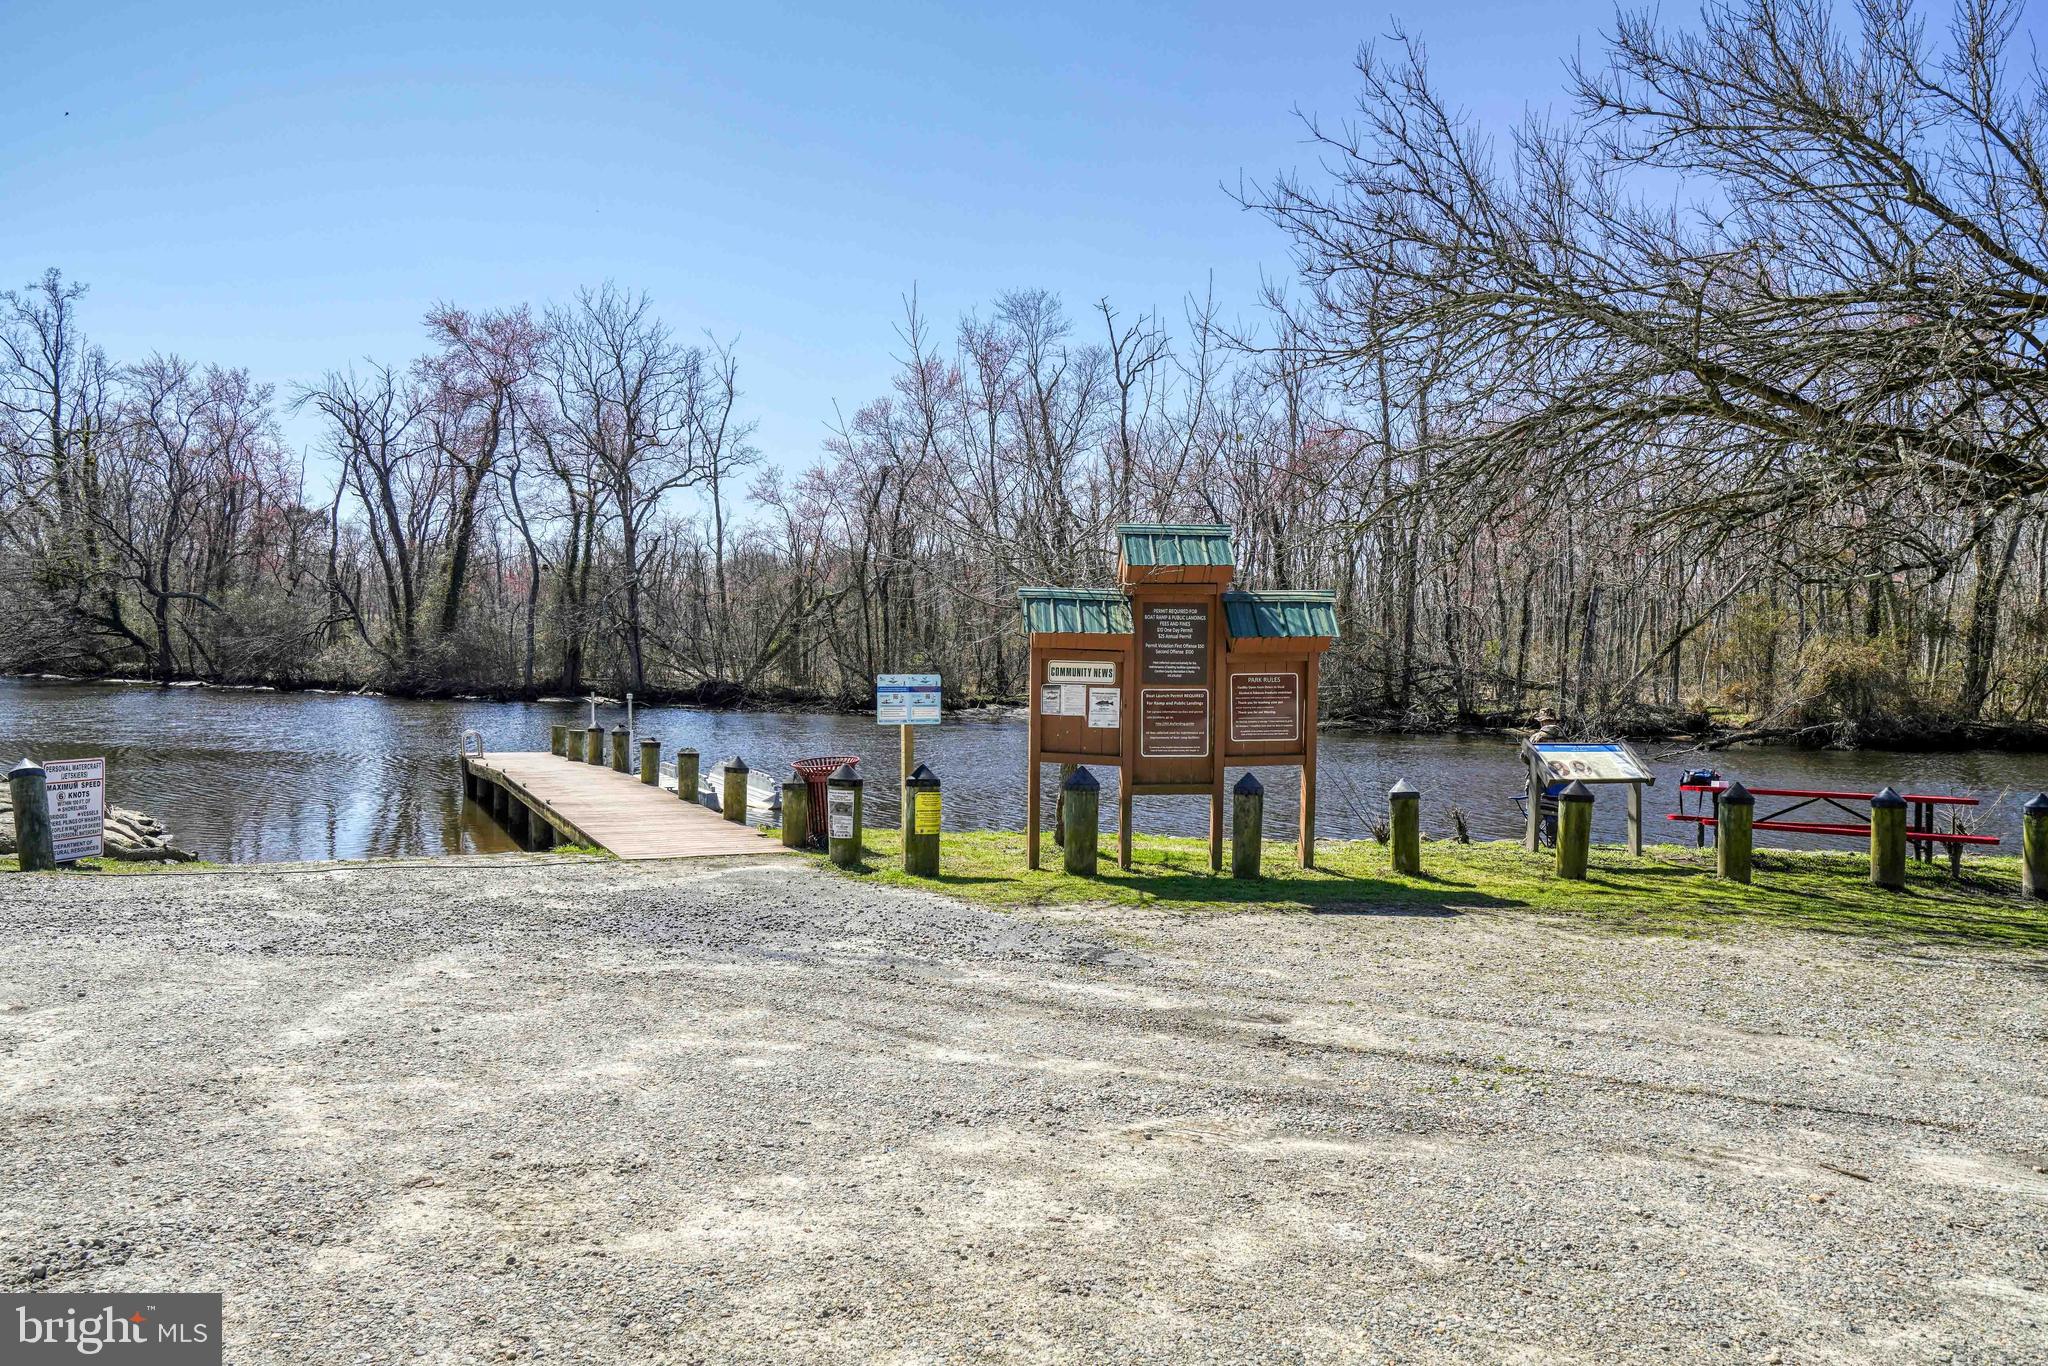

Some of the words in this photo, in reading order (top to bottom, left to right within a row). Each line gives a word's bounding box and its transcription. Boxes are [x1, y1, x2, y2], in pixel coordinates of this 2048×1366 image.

[1050, 667, 1092, 677] COMMUNITY
[1094, 668, 1113, 678] NEWS
[54, 841, 86, 850] DEPARTMENT
[70, 845, 99, 853] RESOURCES
